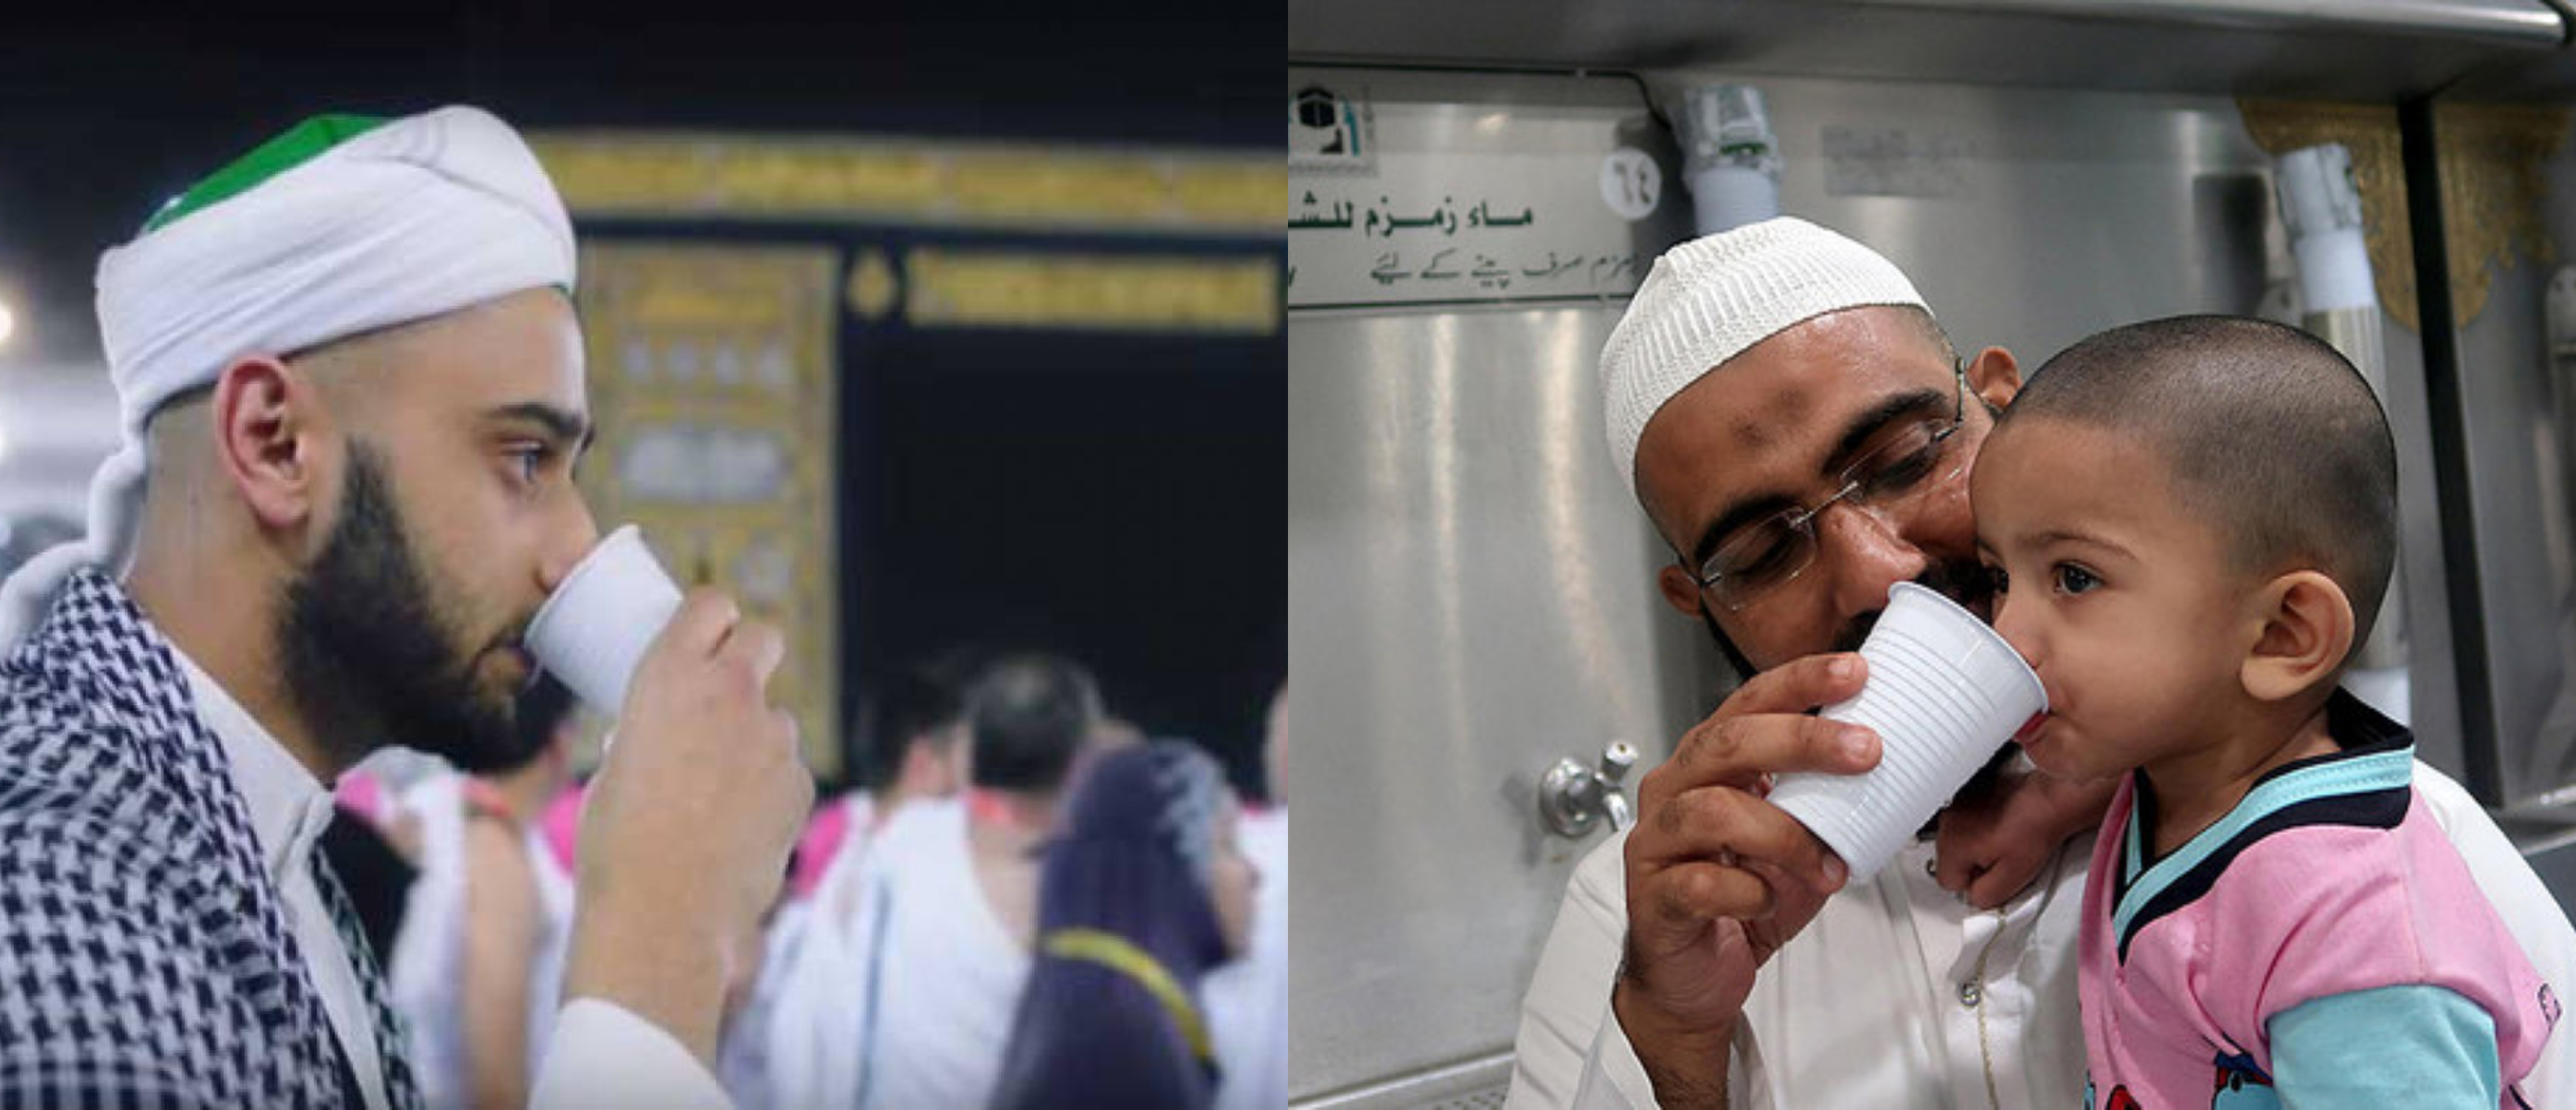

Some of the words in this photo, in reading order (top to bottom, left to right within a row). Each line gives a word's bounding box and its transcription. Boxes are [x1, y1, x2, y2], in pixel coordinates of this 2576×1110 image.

[1288, 189, 1354, 228] للش
[1365, 195, 1458, 238] زمزم
[1467, 198, 1533, 227] ماء
